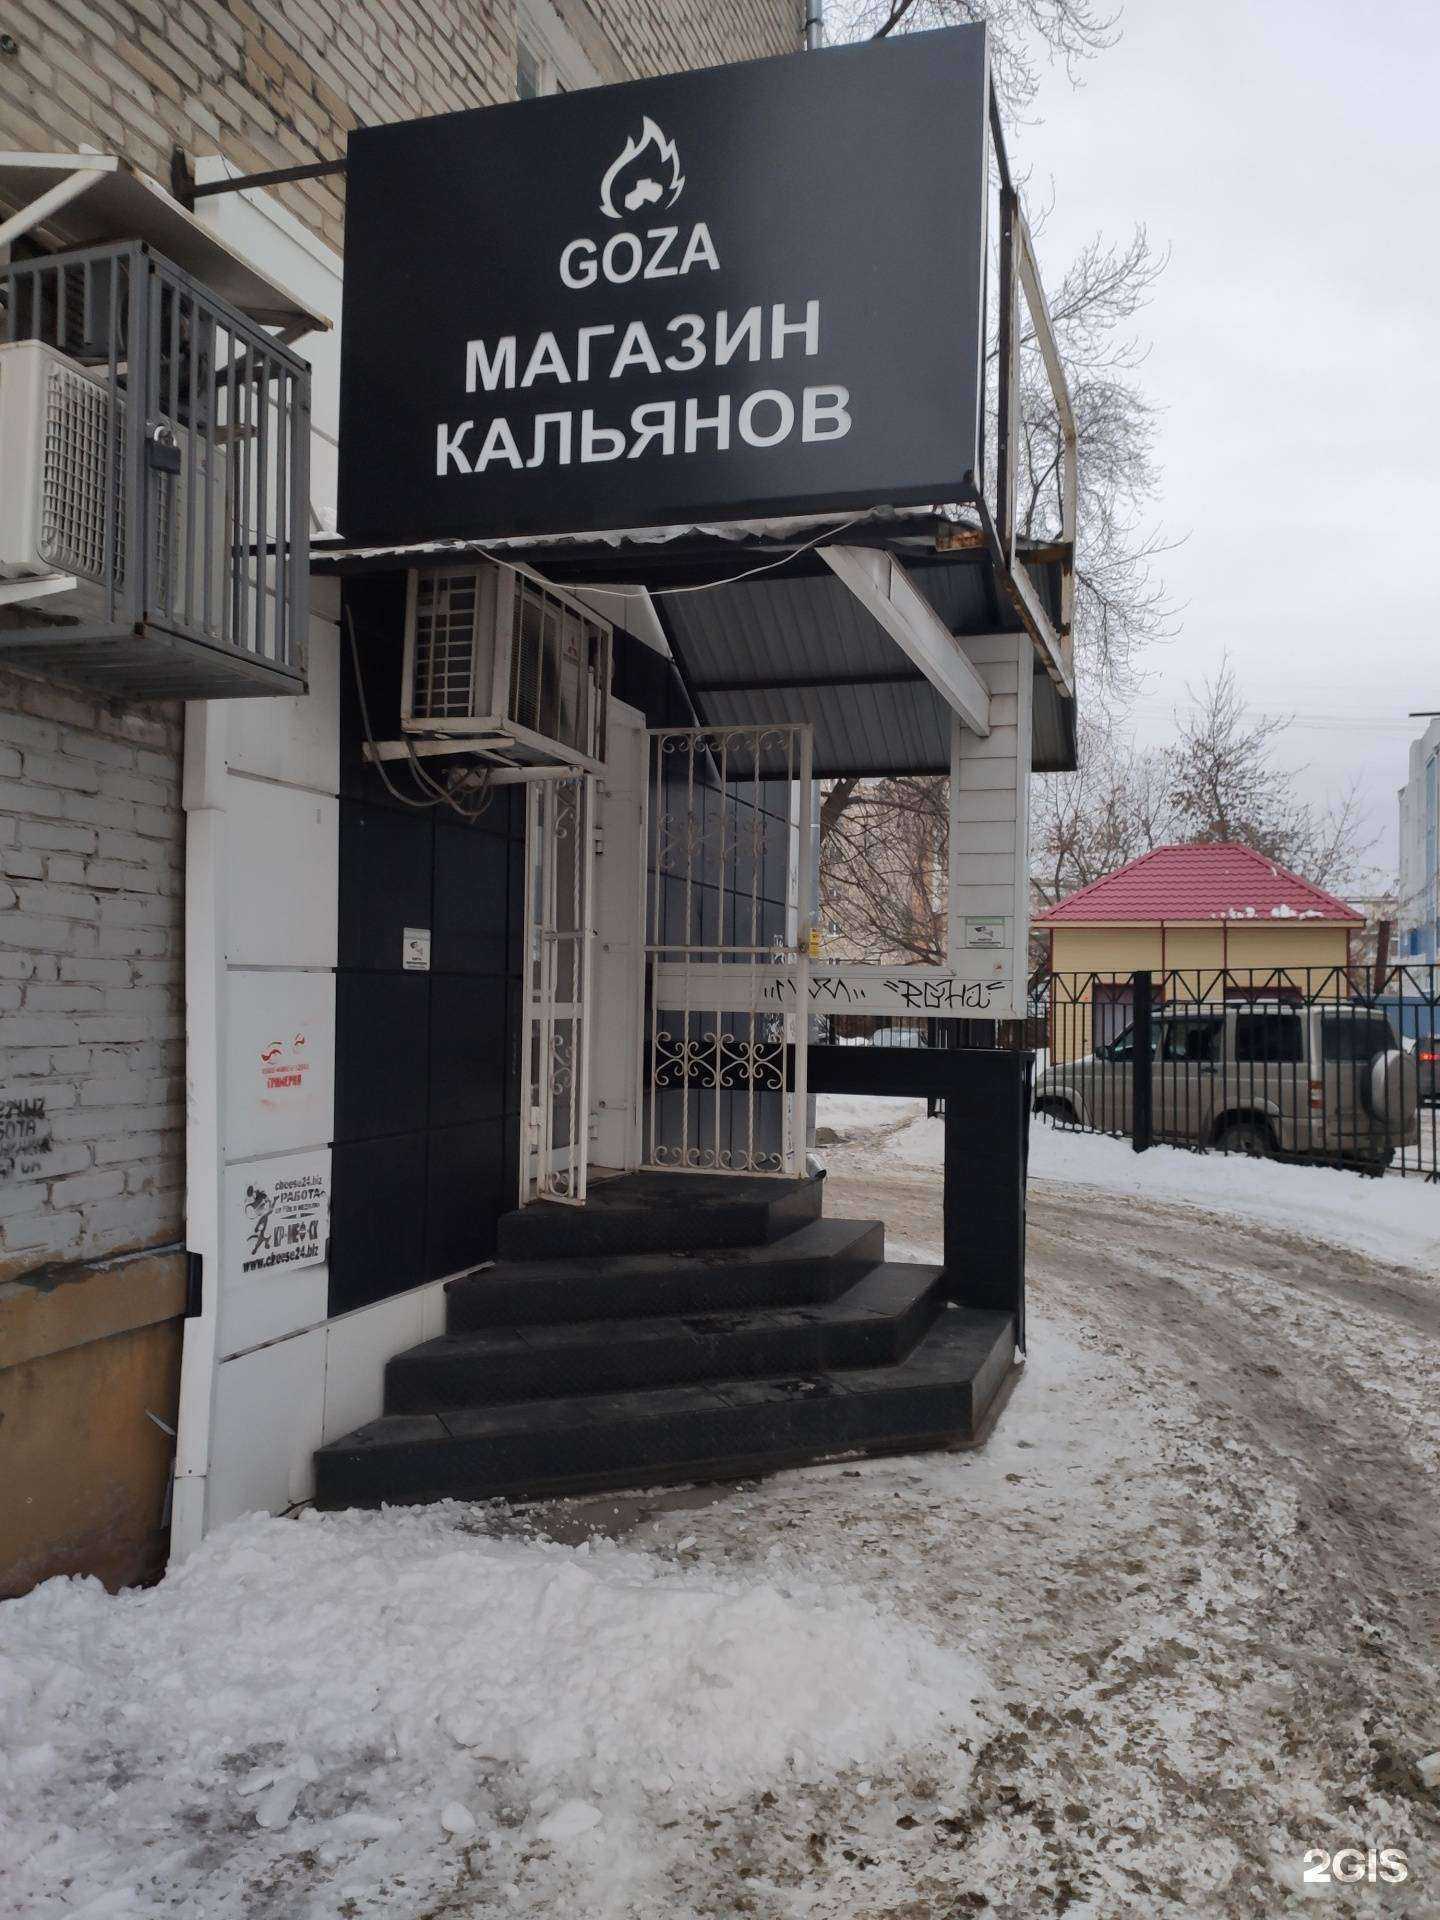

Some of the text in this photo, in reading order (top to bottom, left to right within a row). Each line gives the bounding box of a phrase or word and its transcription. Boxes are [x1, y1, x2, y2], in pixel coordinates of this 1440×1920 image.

[558, 222, 721, 290] GOZA
[464, 299, 821, 393] МАГАЗИН
[435, 384, 854, 476] КАЛЬЯНОВ
[280, 1187, 321, 1203] РАБОТА
[242, 1243, 320, 1273] www.cheese24.biz
